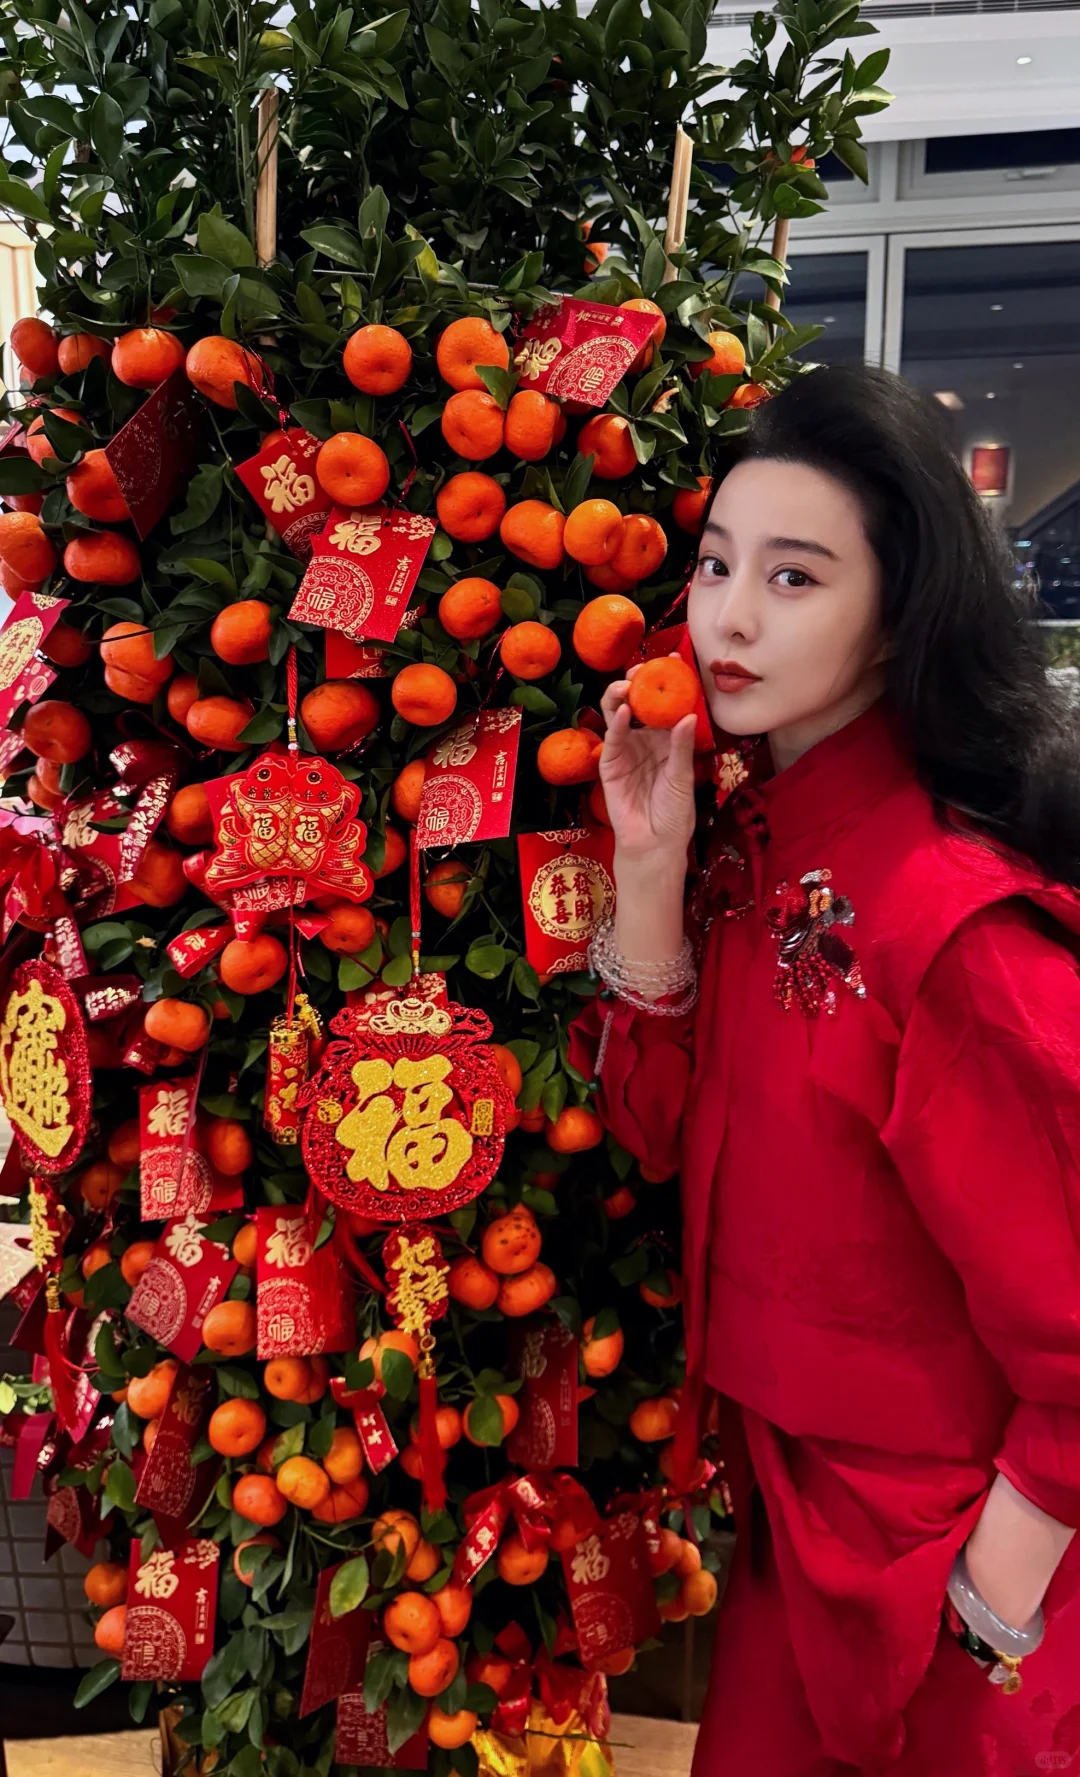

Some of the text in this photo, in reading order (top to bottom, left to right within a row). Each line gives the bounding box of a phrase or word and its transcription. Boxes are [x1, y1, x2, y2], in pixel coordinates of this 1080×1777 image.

[514, 337, 562, 380] 福
[578, 366, 605, 392] 福
[260, 455, 315, 513] 福
[328, 512, 382, 556] 福
[306, 587, 336, 611] 福
[432, 724, 478, 769] 福
[252, 812, 276, 840] 福
[295, 815, 320, 843] 福
[425, 806, 450, 831] 福
[147, 1088, 190, 1138] 福
[335, 1054, 473, 1191] 福
[151, 1177, 177, 1204] 福
[165, 1206, 208, 1268] 福
[265, 1217, 310, 1269] 福
[267, 1313, 296, 1343] 福
[134, 1550, 179, 1599] 福
[570, 1534, 611, 1585] 福
